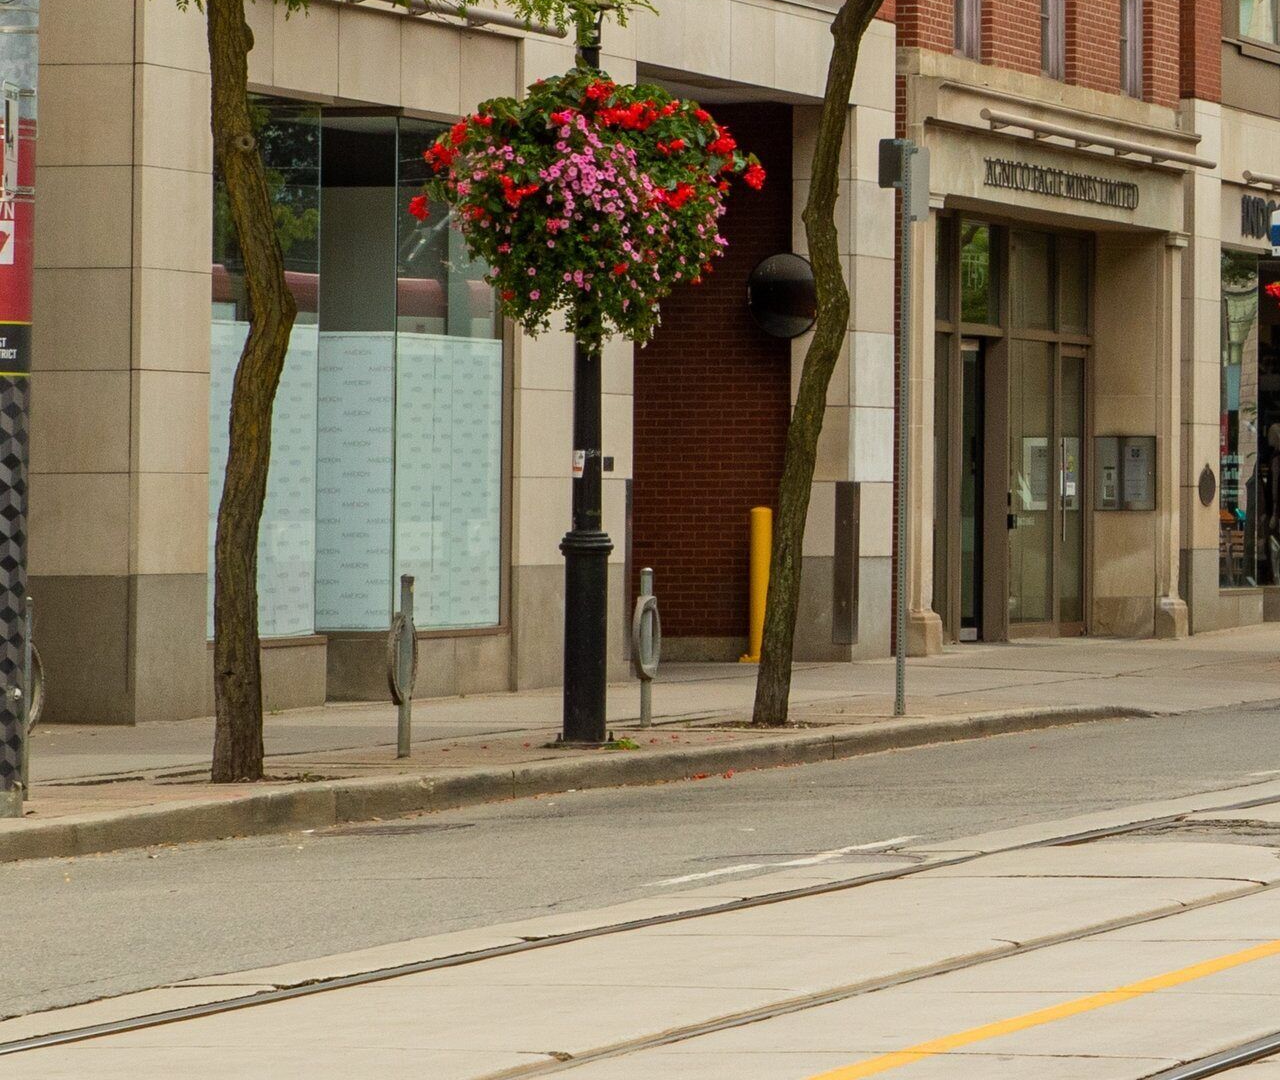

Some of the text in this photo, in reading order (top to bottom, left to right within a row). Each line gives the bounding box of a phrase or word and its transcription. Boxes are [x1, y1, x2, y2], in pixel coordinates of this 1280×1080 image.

[983, 157, 1140, 211] AGNICO EAGLE MINES LIMITED
